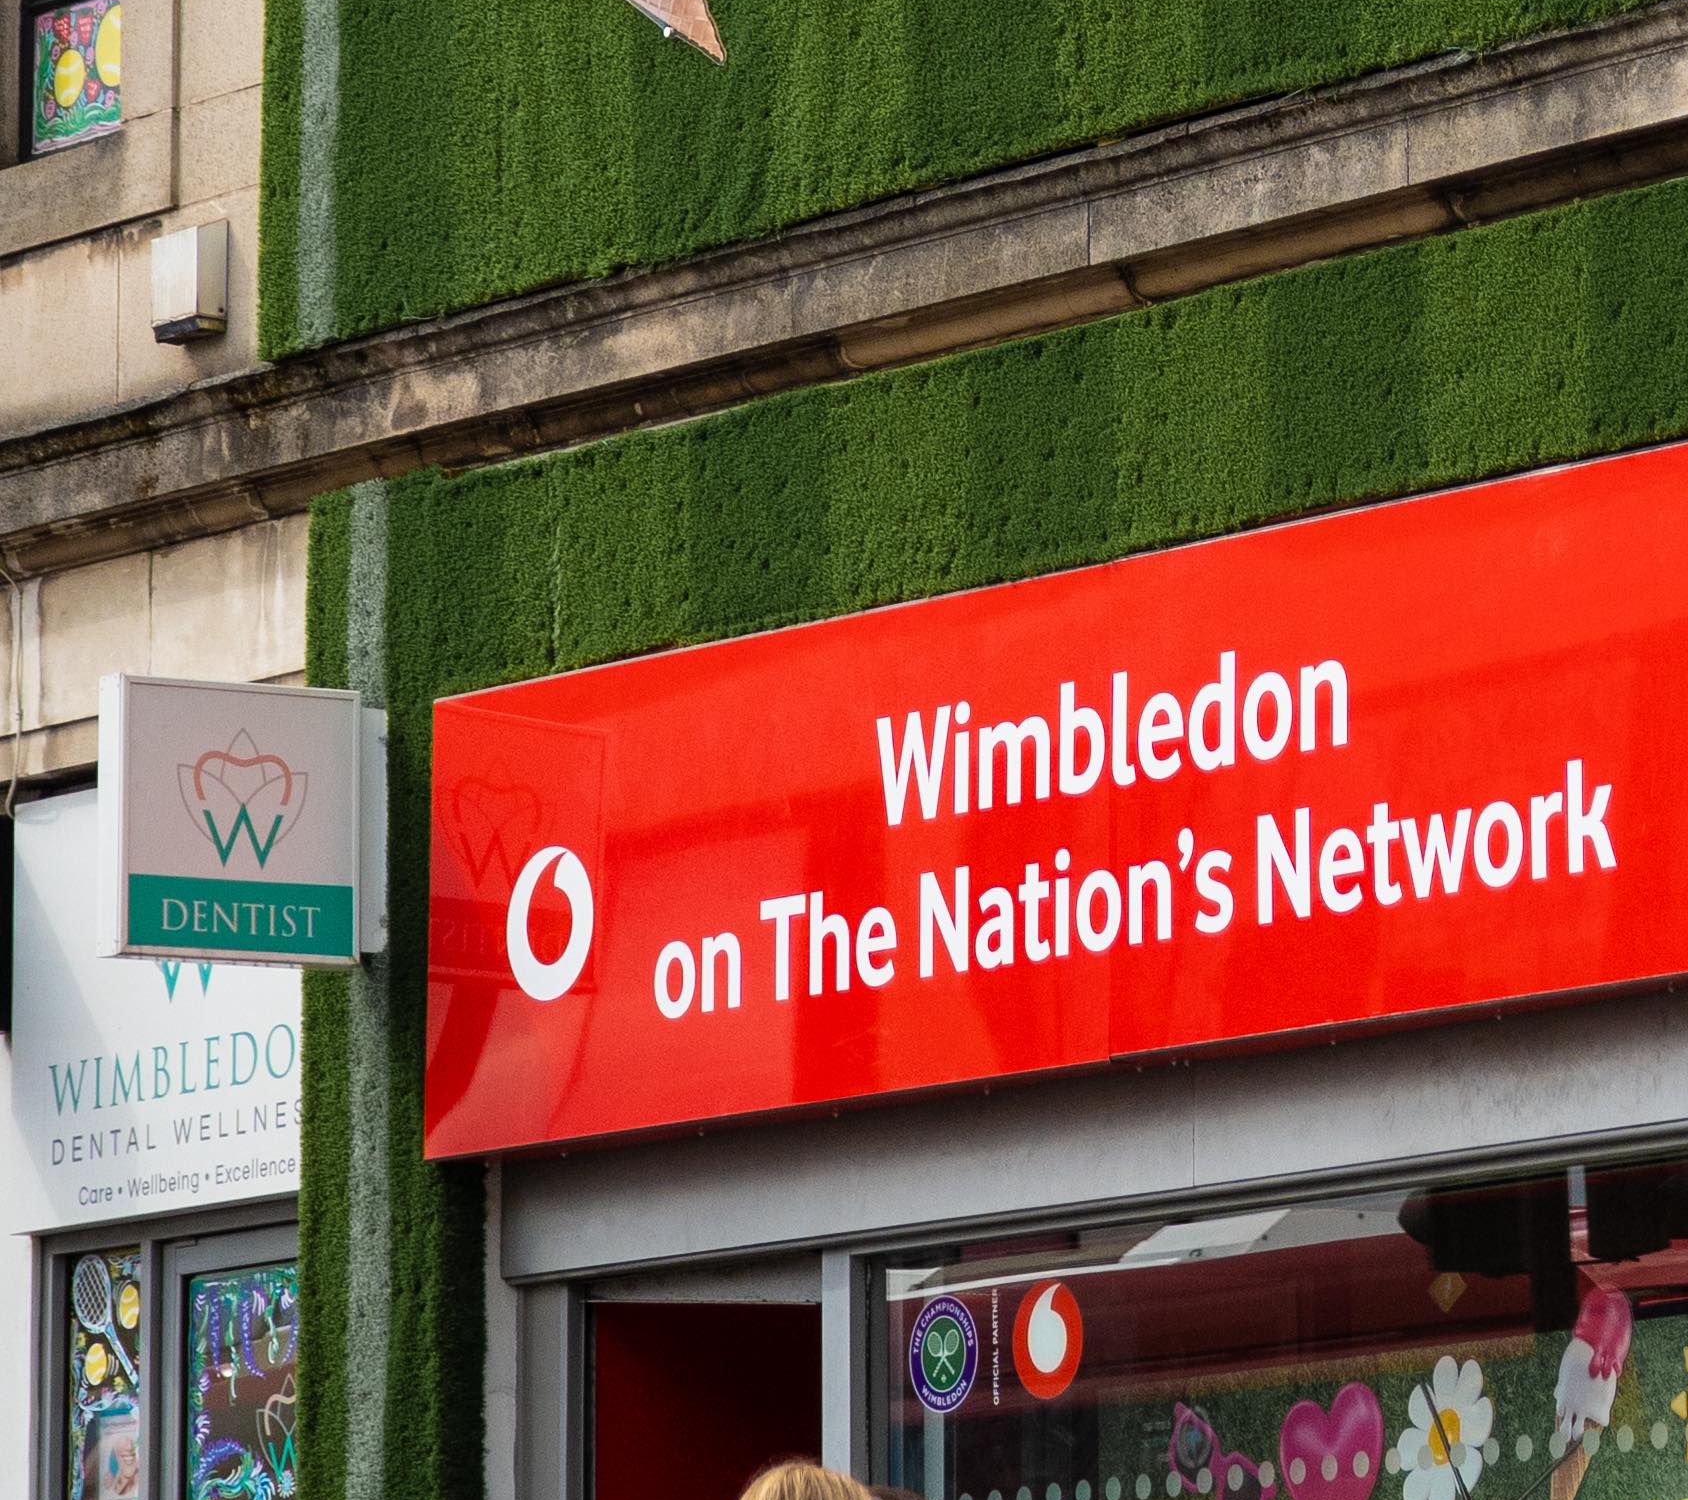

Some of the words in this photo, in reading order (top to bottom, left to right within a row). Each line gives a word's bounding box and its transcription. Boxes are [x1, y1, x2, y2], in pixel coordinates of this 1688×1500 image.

[877, 651, 1349, 827] Wimbledon
[653, 931, 743, 1021] on
[759, 892, 896, 1001] The
[918, 827, 1235, 981] Nation's
[1255, 757, 1619, 928] Network
[160, 896, 321, 939] DENTIST
[48, 1022, 296, 1118] WIMBLEDO
[51, 1122, 157, 1166] DENTAL
[78, 1184, 113, 1207] Care
[127, 1170, 200, 1200] Wellbeing
[214, 1154, 297, 1186] Excellence
[913, 1330, 923, 1354] THE
[920, 1301, 975, 1347] CHAMPIONSHIPS
[920, 1378, 968, 1407] WIMBLEDON
[992, 1348, 1000, 1406] OFFICIAL
